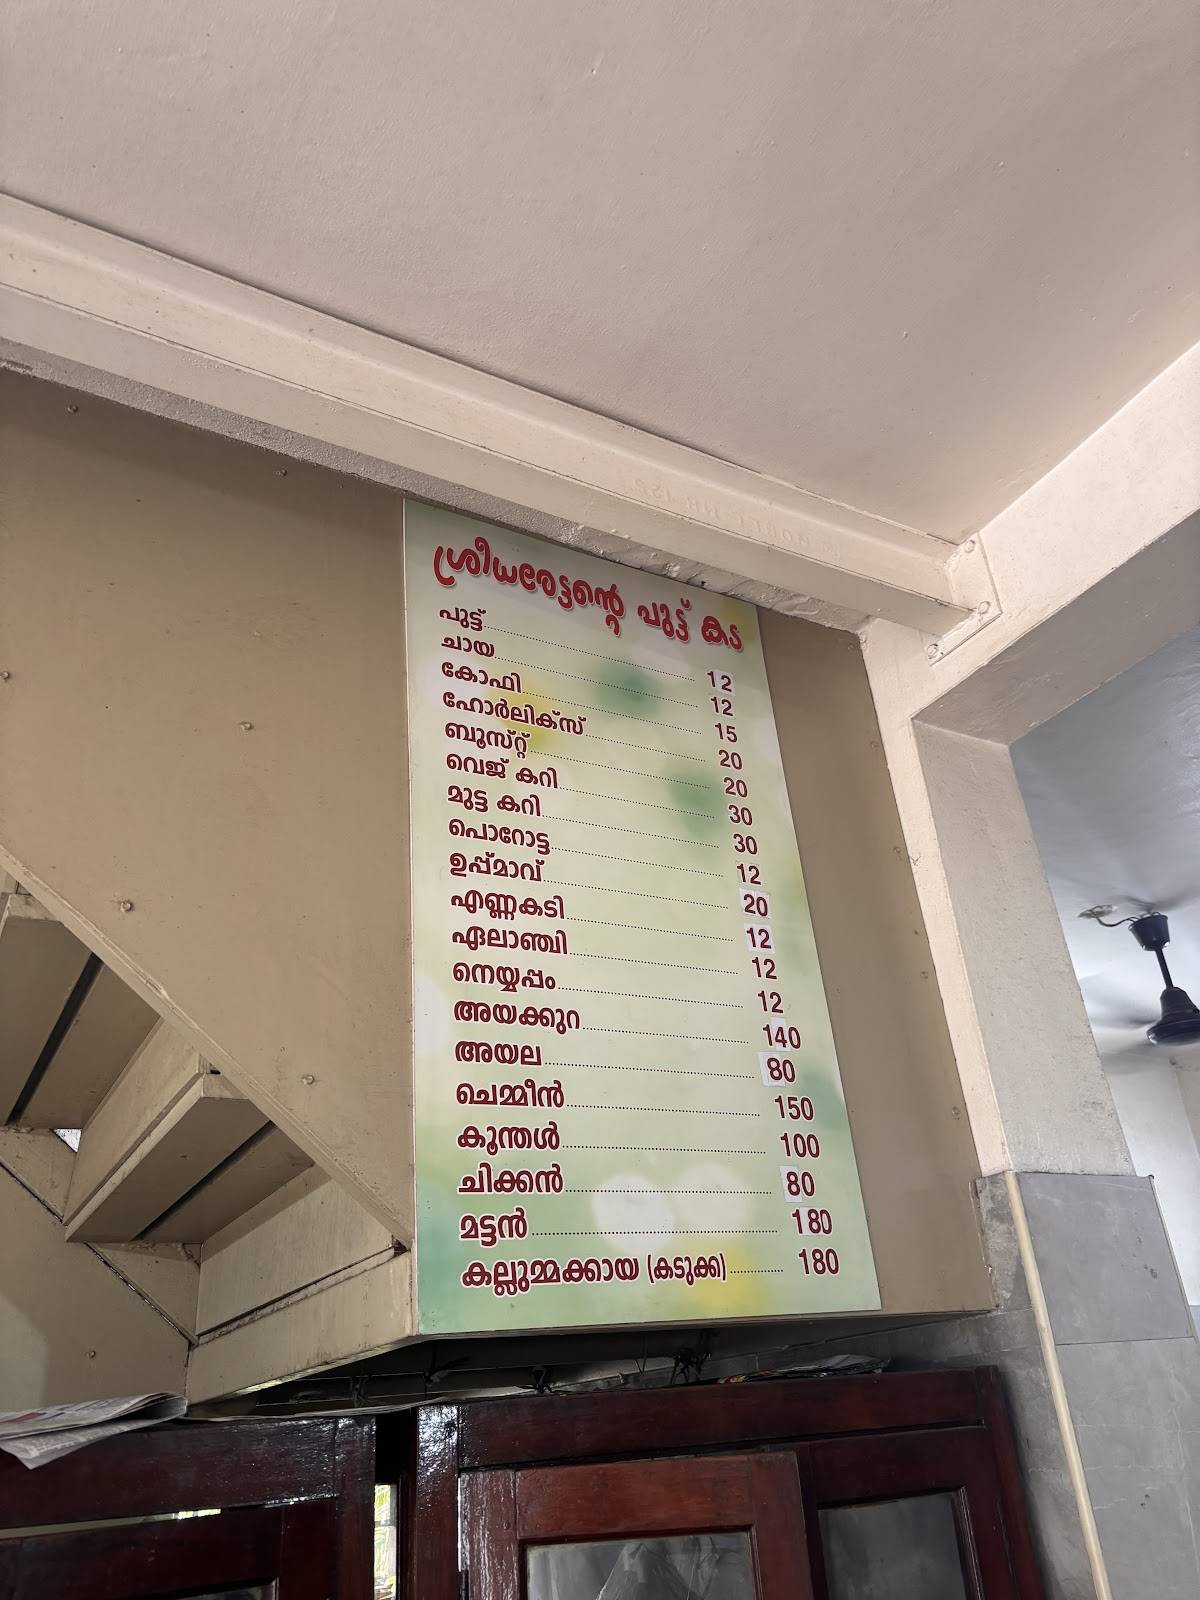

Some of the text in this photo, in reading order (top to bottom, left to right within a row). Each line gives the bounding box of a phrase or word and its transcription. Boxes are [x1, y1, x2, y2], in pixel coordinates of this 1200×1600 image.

[637, 597, 693, 645] പുട്ട്
[700, 614, 745, 653] കട
[439, 606, 733, 693] പുട്ട് 12
[441, 635, 734, 718] ചായ 12
[441, 660, 738, 744] കോഫി 15
[718, 749, 744, 771] 20
[446, 753, 754, 827] വെജ് കറി 30
[723, 776, 749, 799] 20
[447, 785, 758, 856] മുട്ട കറി 30
[448, 818, 762, 886] പൊറോട്ട 12
[450, 889, 772, 950] എണ്ണകടി 12
[743, 893, 769, 917] 20
[452, 962, 784, 1014] നെയ്യപ്പം 12
[751, 956, 778, 980] 12
[453, 1000, 801, 1050] അയക്കുറ 140
[454, 1040, 797, 1083] അയല 80
[456, 1078, 815, 1121] ചെമ്മീൻ 150
[780, 1132, 820, 1158] 100
[458, 1162, 815, 1197] ചിക്കൻ 80
[460, 1207, 833, 1247] മട്ടൻ 180
[647, 1253, 726, 1286] (കടുക്ക)
[798, 1248, 840, 1275] 180
